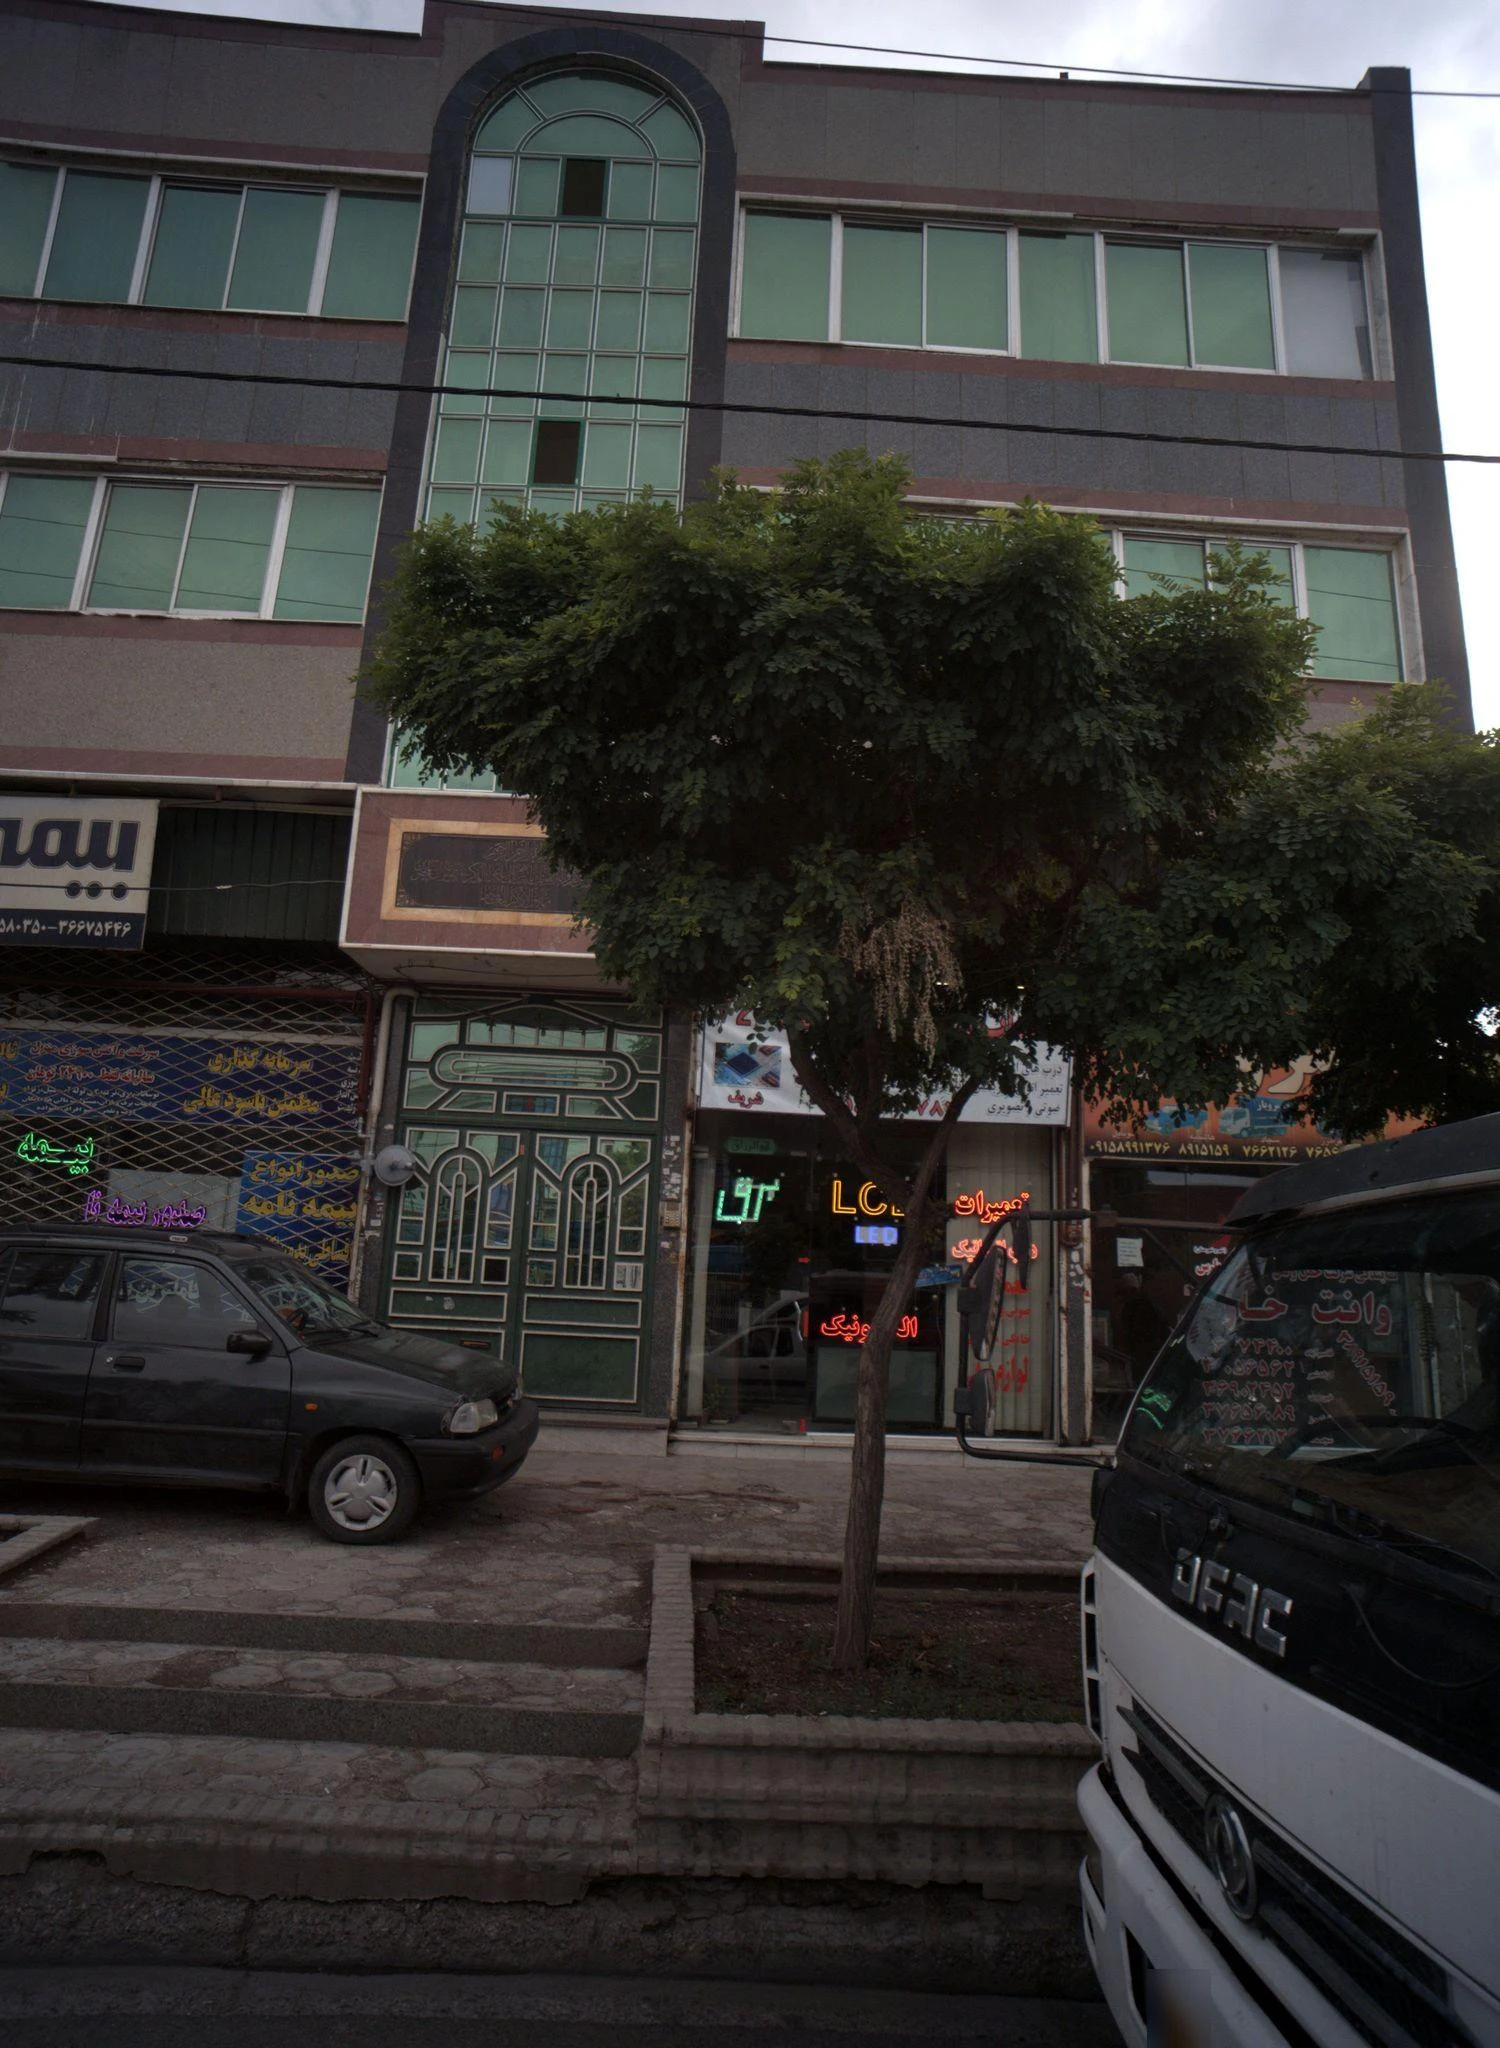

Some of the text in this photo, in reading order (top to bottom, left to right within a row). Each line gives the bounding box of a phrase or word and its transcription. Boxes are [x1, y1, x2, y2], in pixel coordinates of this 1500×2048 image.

[1178, 1143, 1230, 1158] ۸۹۱۵۱۵۹
[855, 1225, 898, 1245] LED
[1312, 1289, 1392, 1336] وانت
